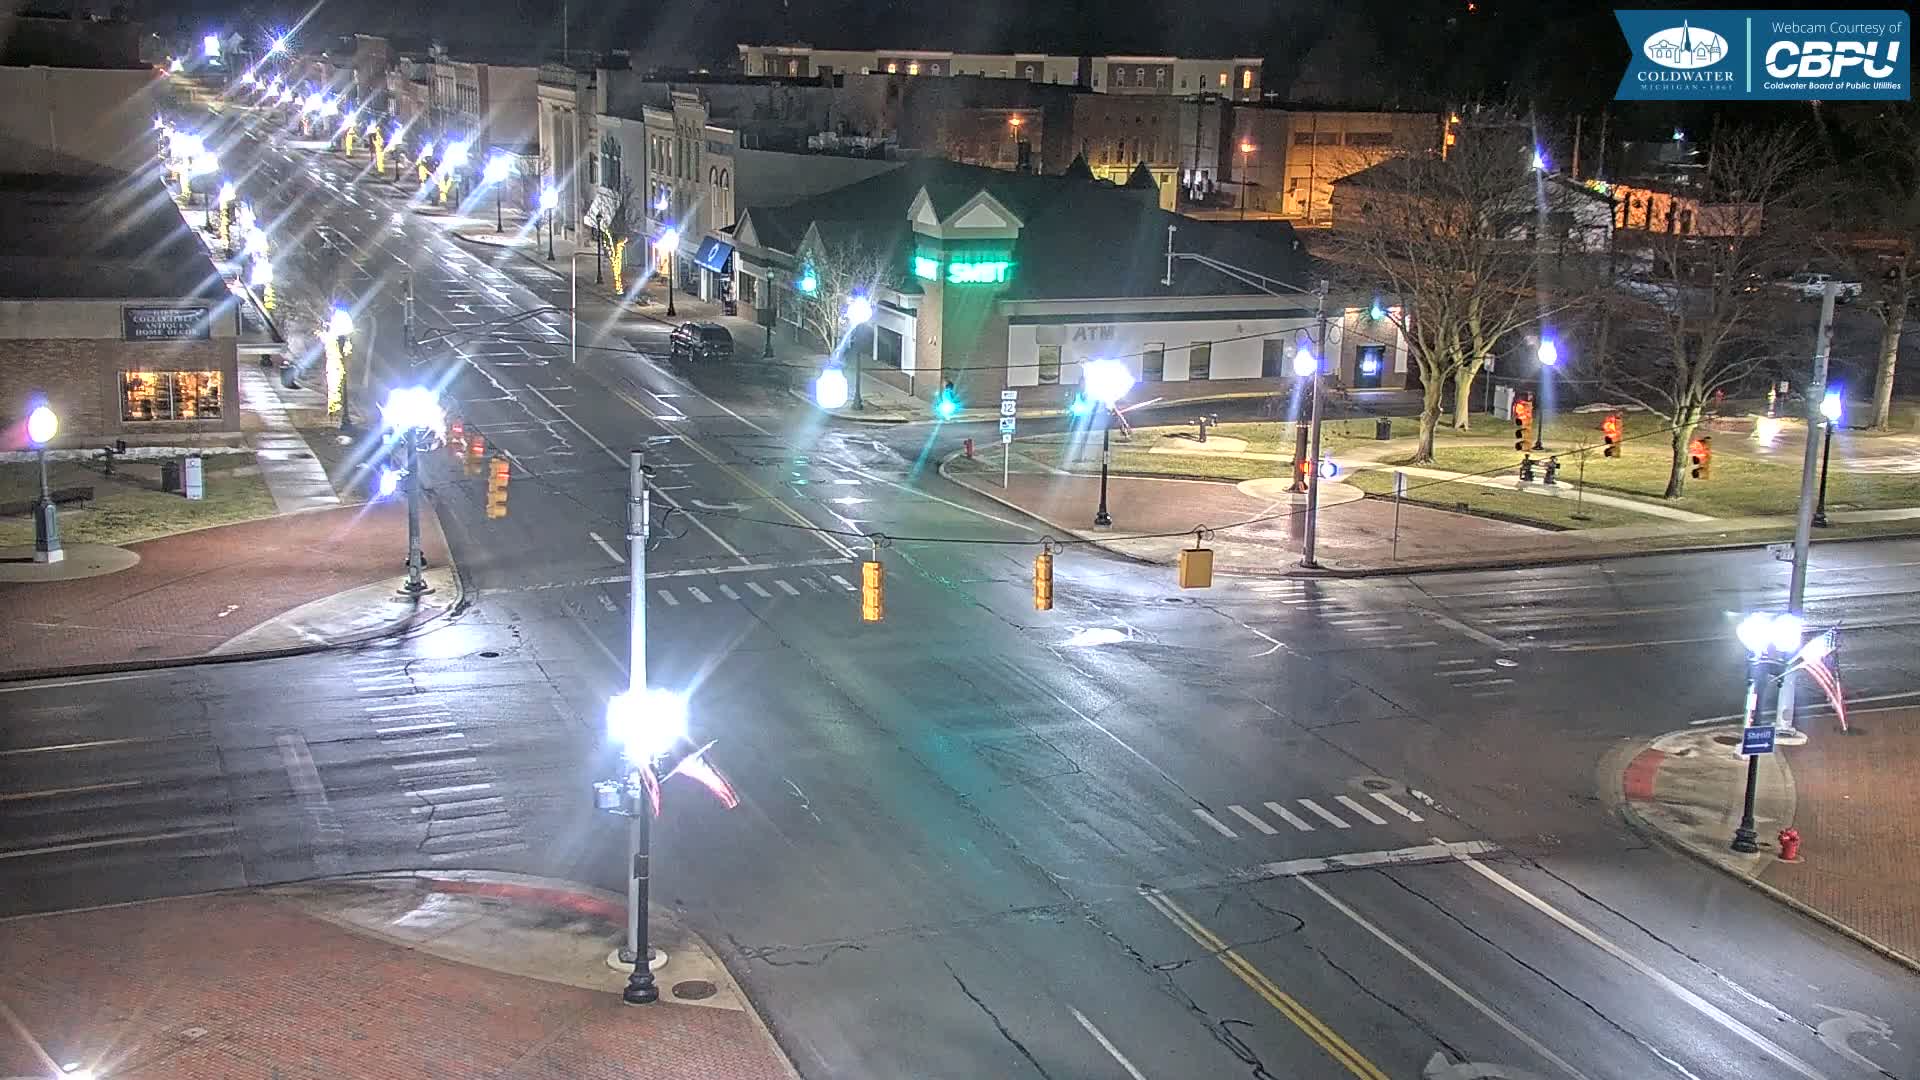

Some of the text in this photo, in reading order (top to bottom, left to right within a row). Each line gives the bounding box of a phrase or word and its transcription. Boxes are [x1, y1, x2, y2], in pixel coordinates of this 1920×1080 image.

[145, 322, 192, 330] ANTIQUES
[135, 329, 162, 337] HOME
[1072, 325, 1115, 342] ATM
[1003, 403, 1013, 413] 12
